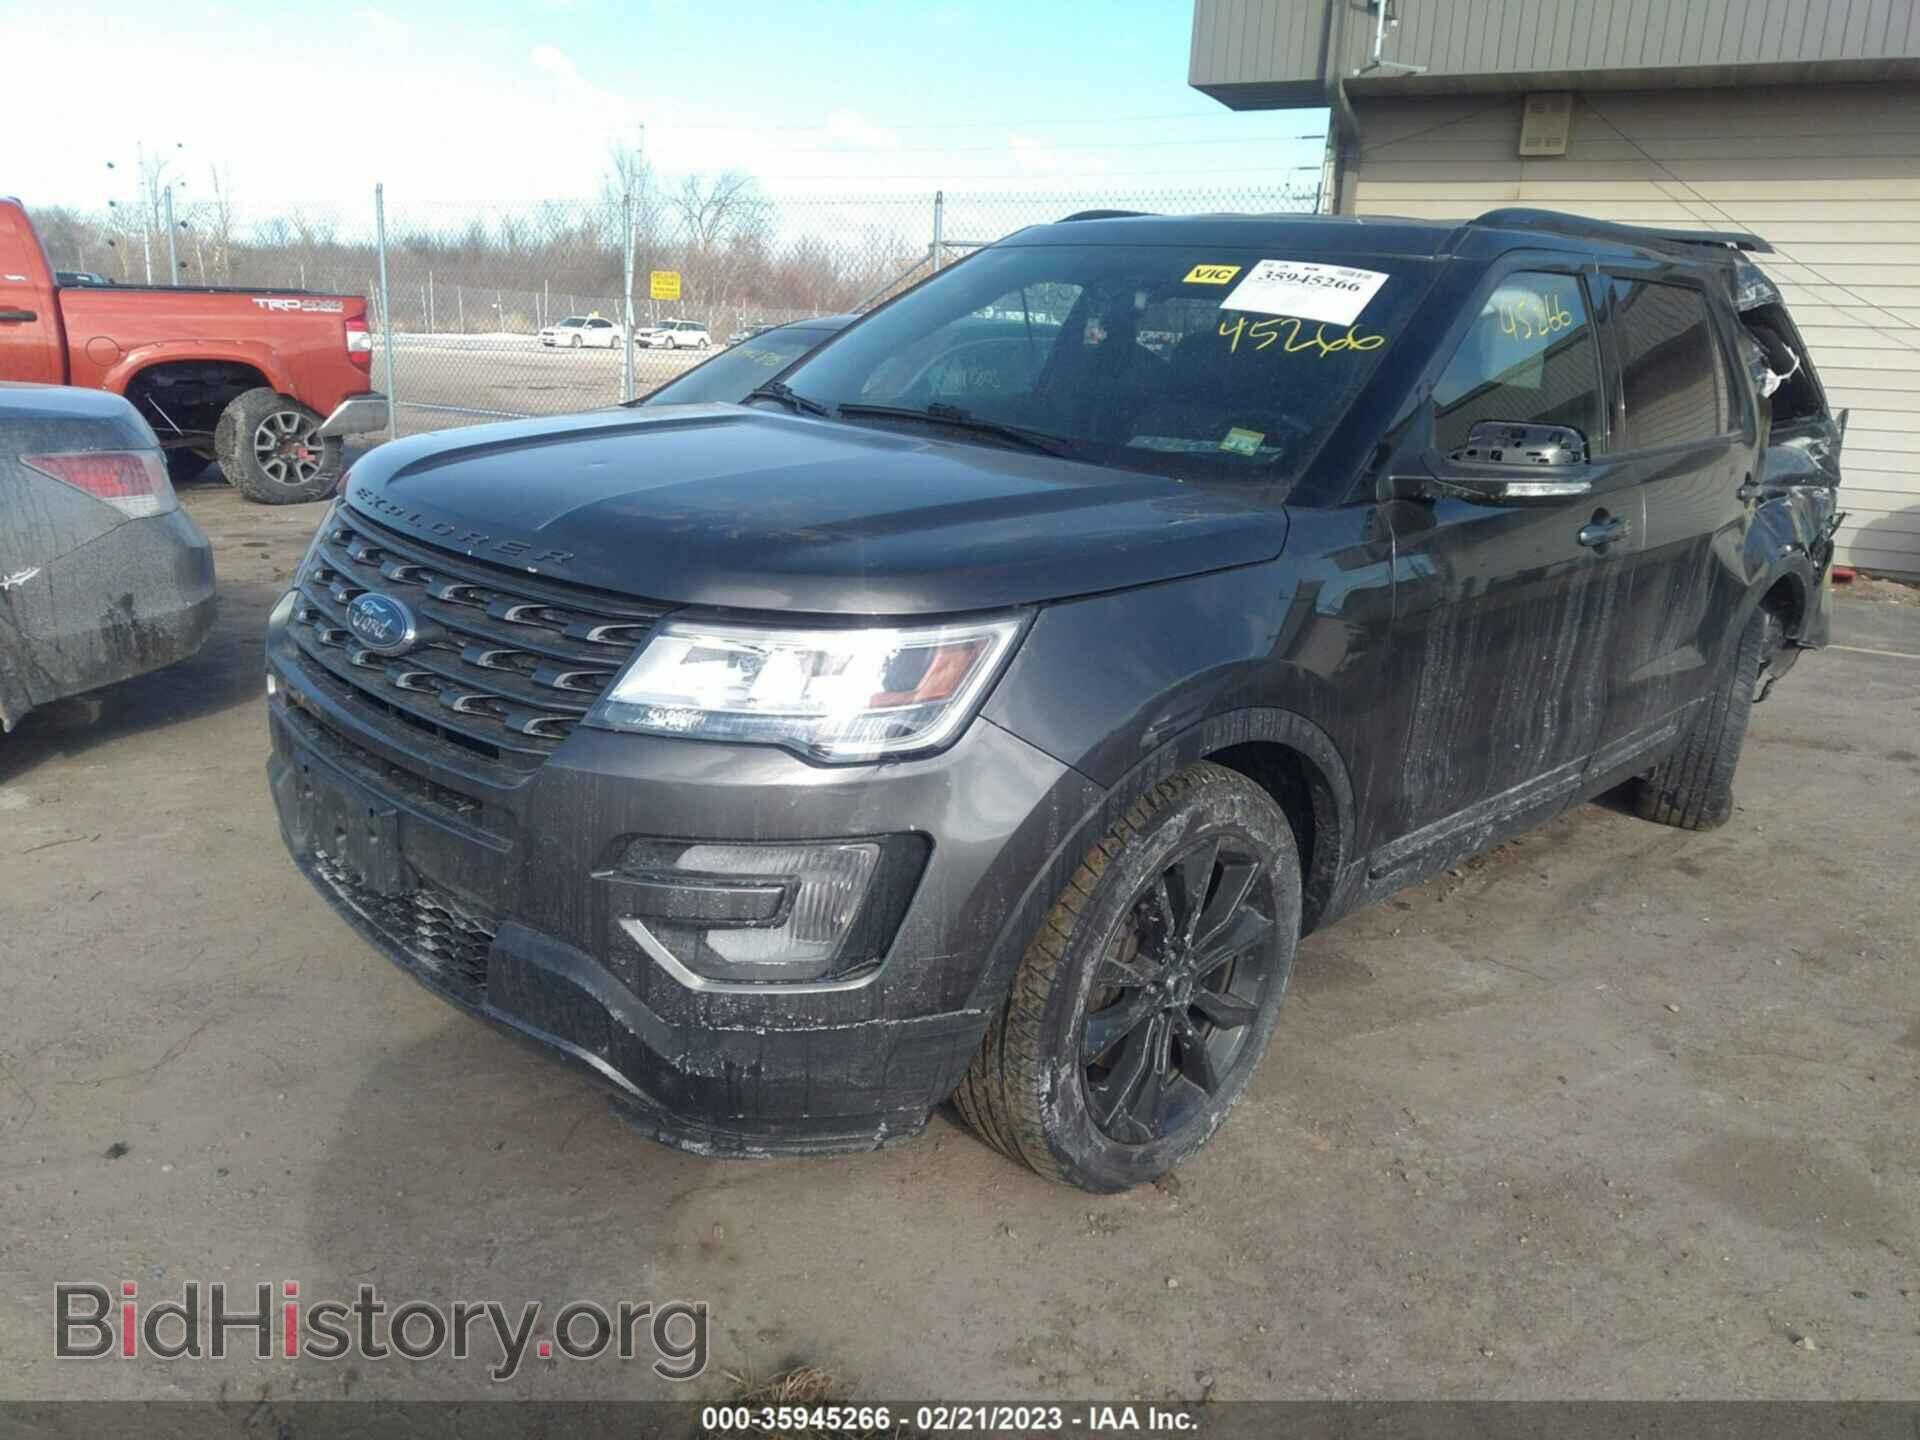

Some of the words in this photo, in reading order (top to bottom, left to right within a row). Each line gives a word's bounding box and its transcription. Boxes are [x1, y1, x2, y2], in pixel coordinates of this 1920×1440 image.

[1194, 268, 1233, 280] VIC
[1258, 270, 1361, 293] 35945266
[252, 298, 301, 311] TRD
[1499, 294, 1573, 342] 45266
[1219, 317, 1385, 357] 45266
[356, 487, 576, 567] EXPLORER
[352, 600, 393, 639] Ford
